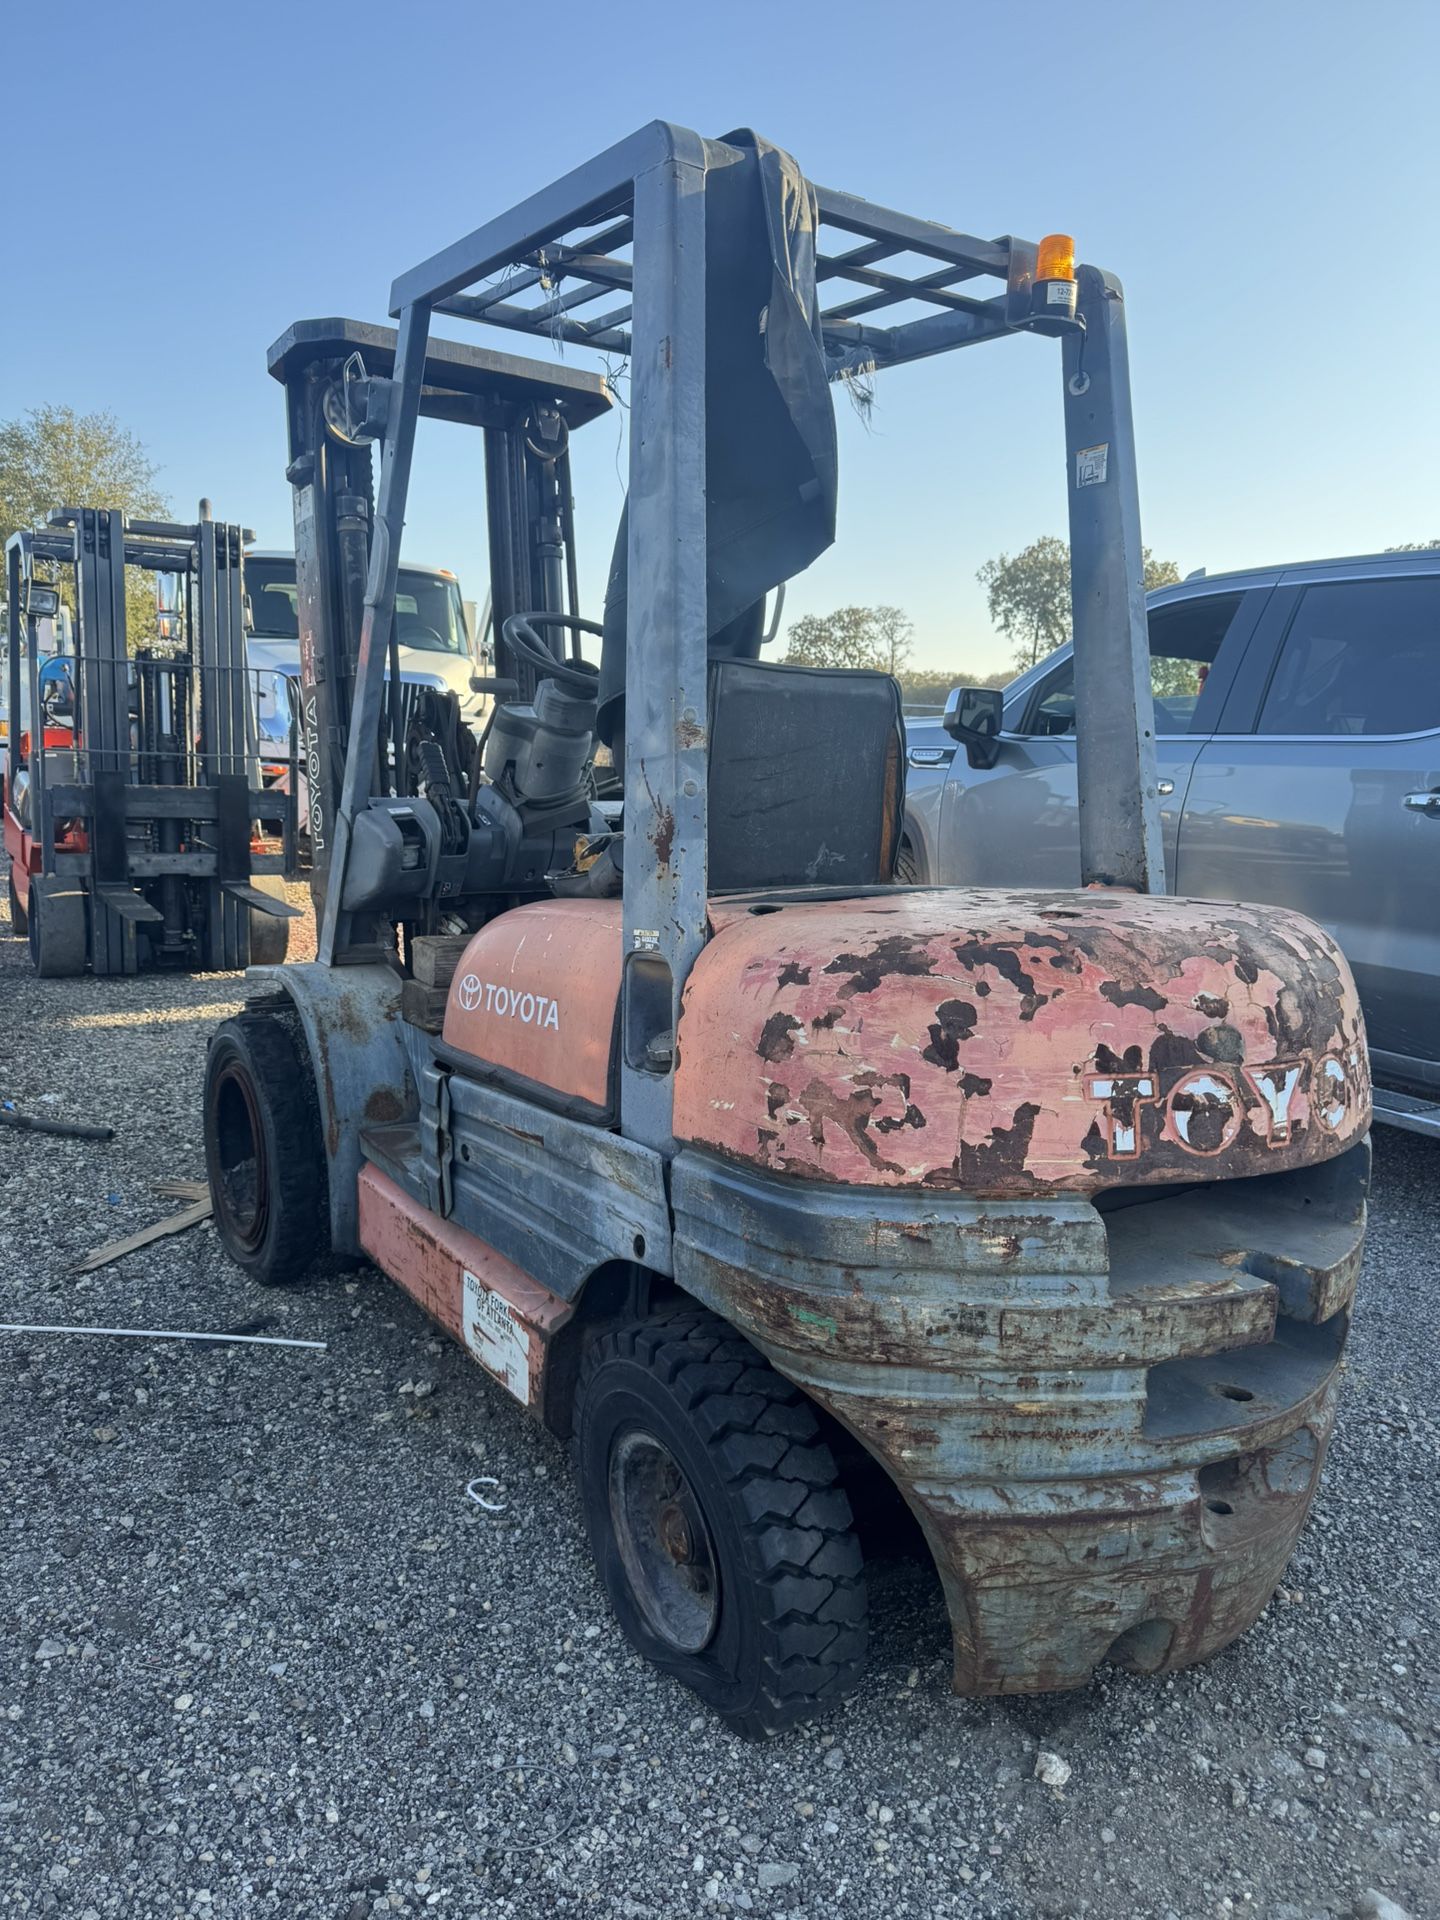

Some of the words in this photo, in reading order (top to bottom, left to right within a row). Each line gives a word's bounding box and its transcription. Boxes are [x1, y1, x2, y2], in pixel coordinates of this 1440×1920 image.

[306, 696, 325, 851] TOYOTA
[486, 983, 559, 1031] TOYOTA
[1082, 1044, 1371, 1161] TOYO
